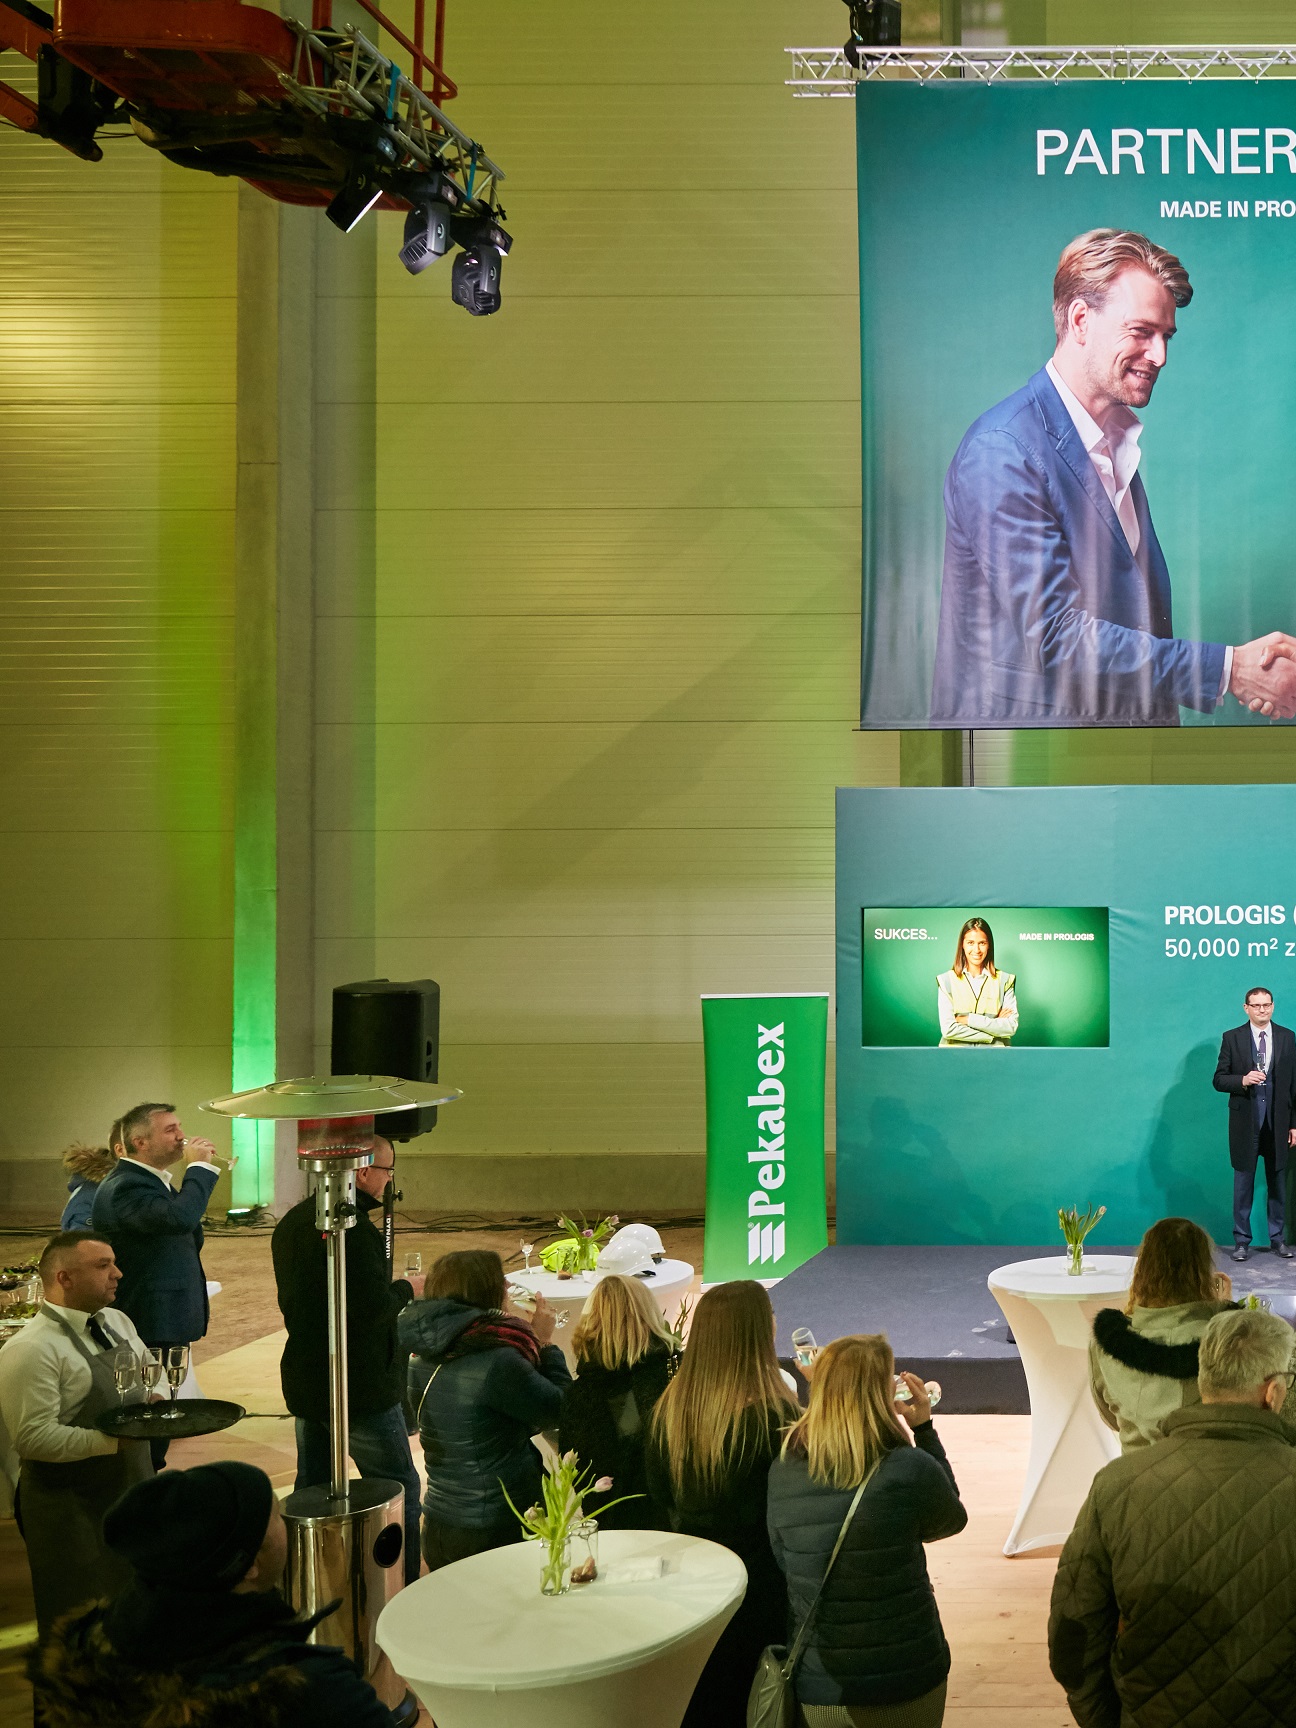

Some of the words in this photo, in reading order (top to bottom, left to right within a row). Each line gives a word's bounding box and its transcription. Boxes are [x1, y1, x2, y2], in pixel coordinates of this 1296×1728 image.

[1160, 201, 1222, 218] MADE
[1227, 200, 1248, 217] IN
[1164, 904, 1286, 925] PROLOGIS
[874, 927, 938, 941] SUKCES...
[1019, 932, 1042, 942] MADE
[1043, 932, 1052, 941] IN
[1053, 932, 1095, 942] PROLOGIS
[1165, 938, 1240, 960] 50,000
[748, 1022, 786, 1218] Pekabex
